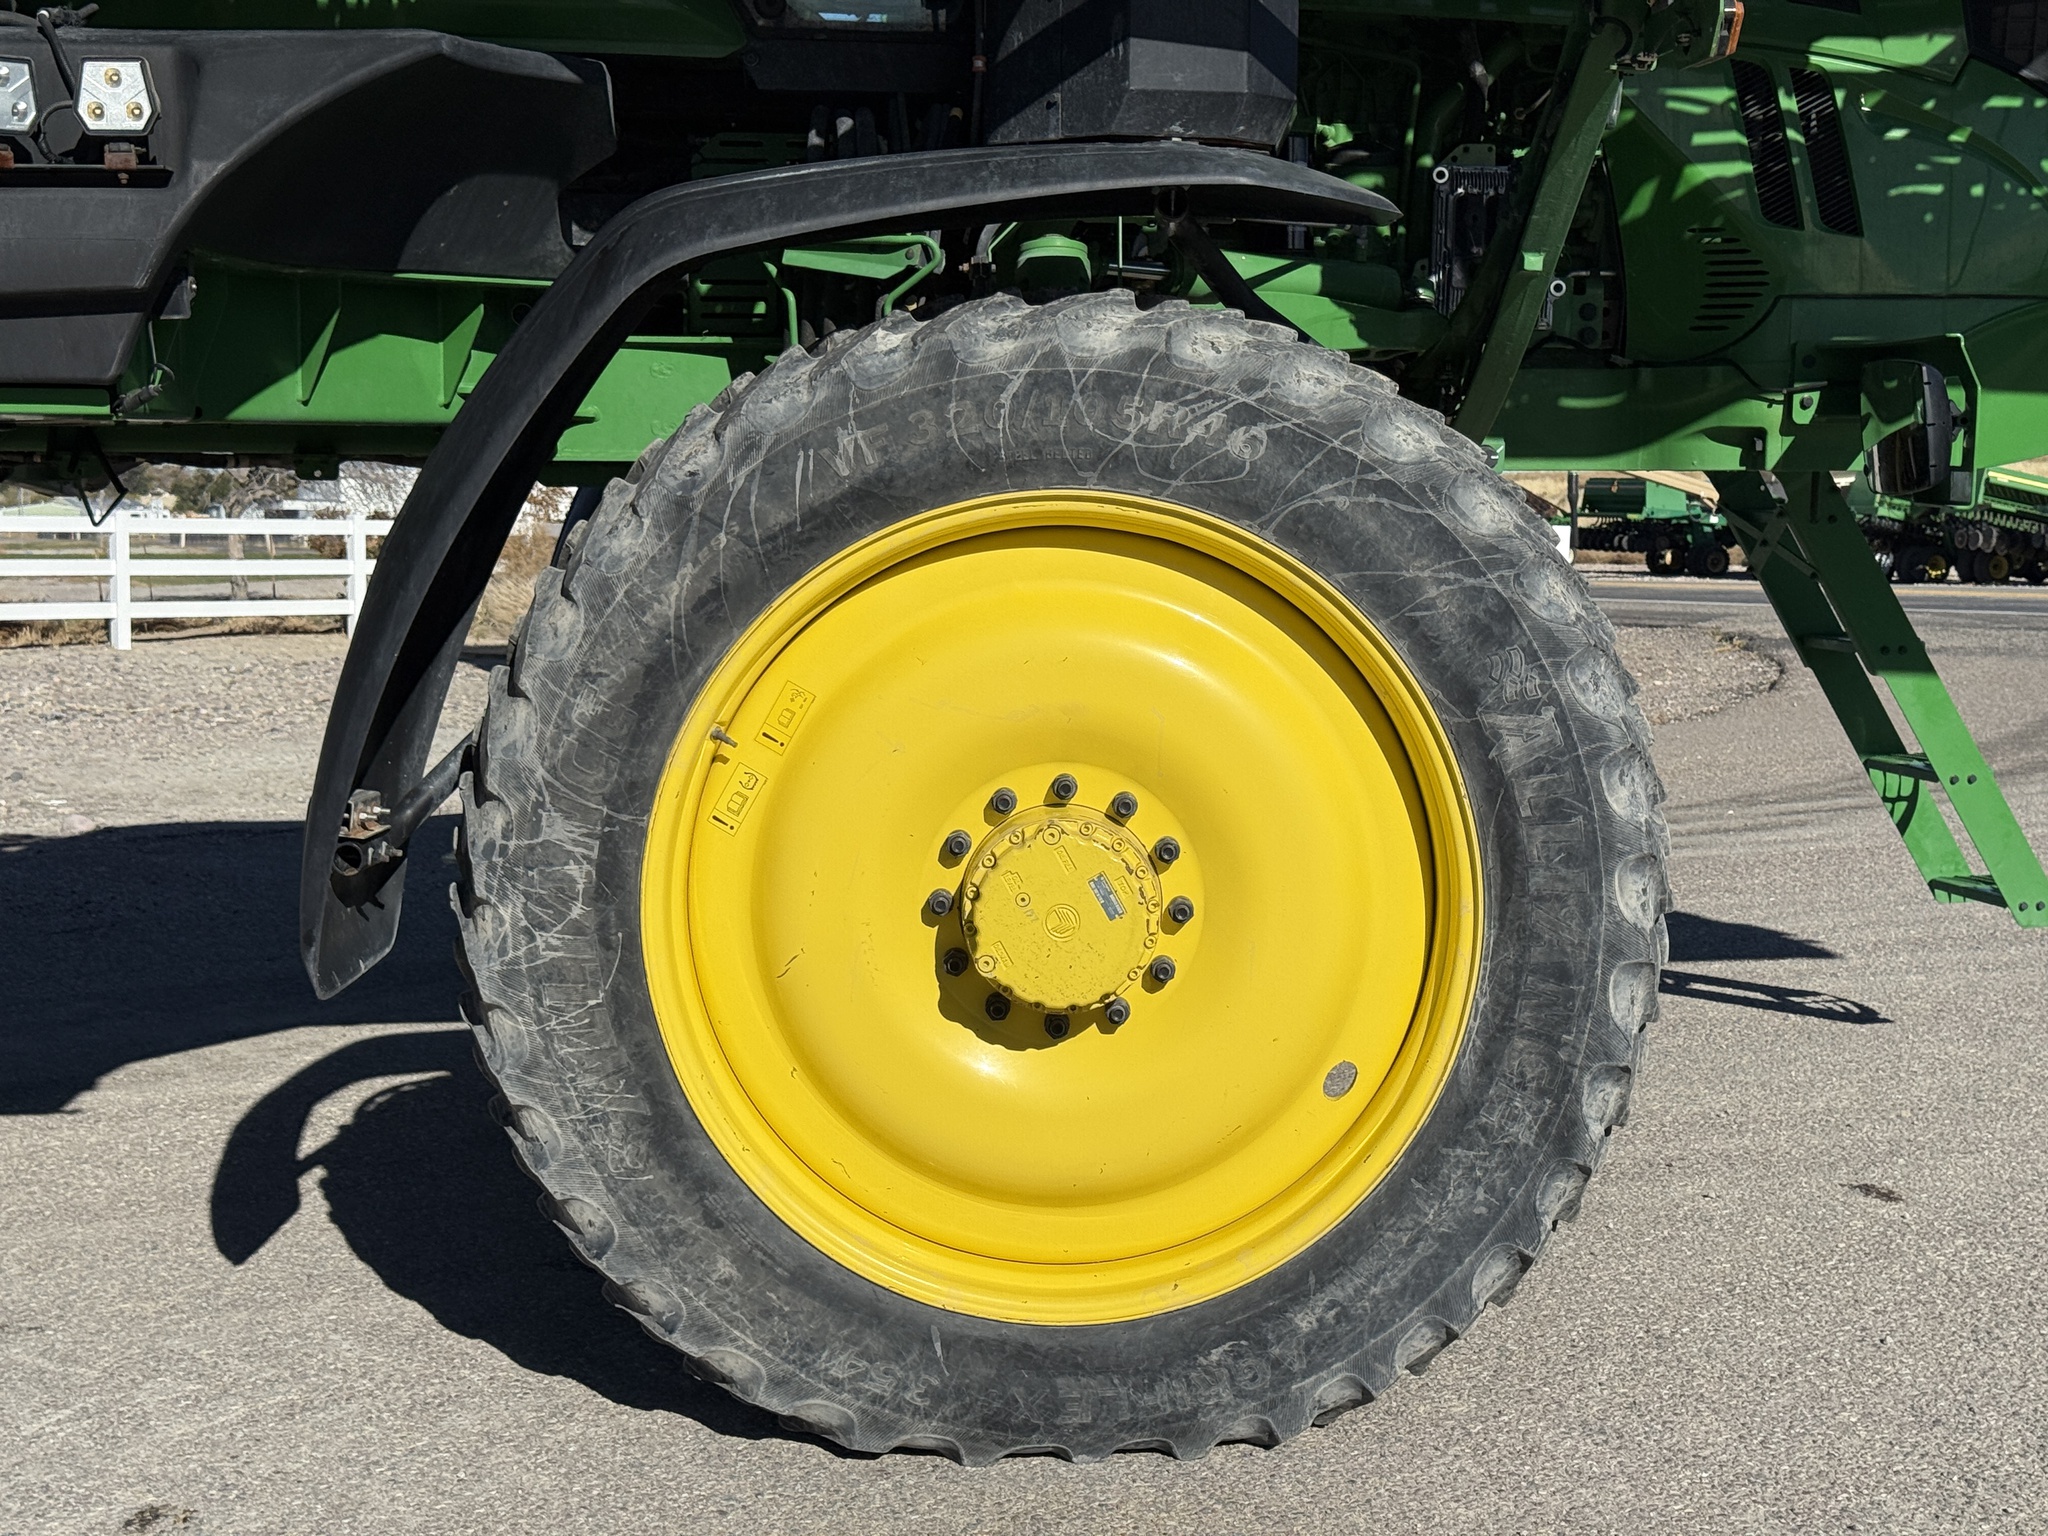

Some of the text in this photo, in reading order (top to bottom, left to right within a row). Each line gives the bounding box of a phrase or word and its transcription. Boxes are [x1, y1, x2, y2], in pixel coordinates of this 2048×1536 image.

[818, 422, 890, 480] VF
[997, 447, 1093, 463] STEEL BELTED
[1474, 683, 1592, 1149] ALLIANCE
[828, 1342, 940, 1407] 354
